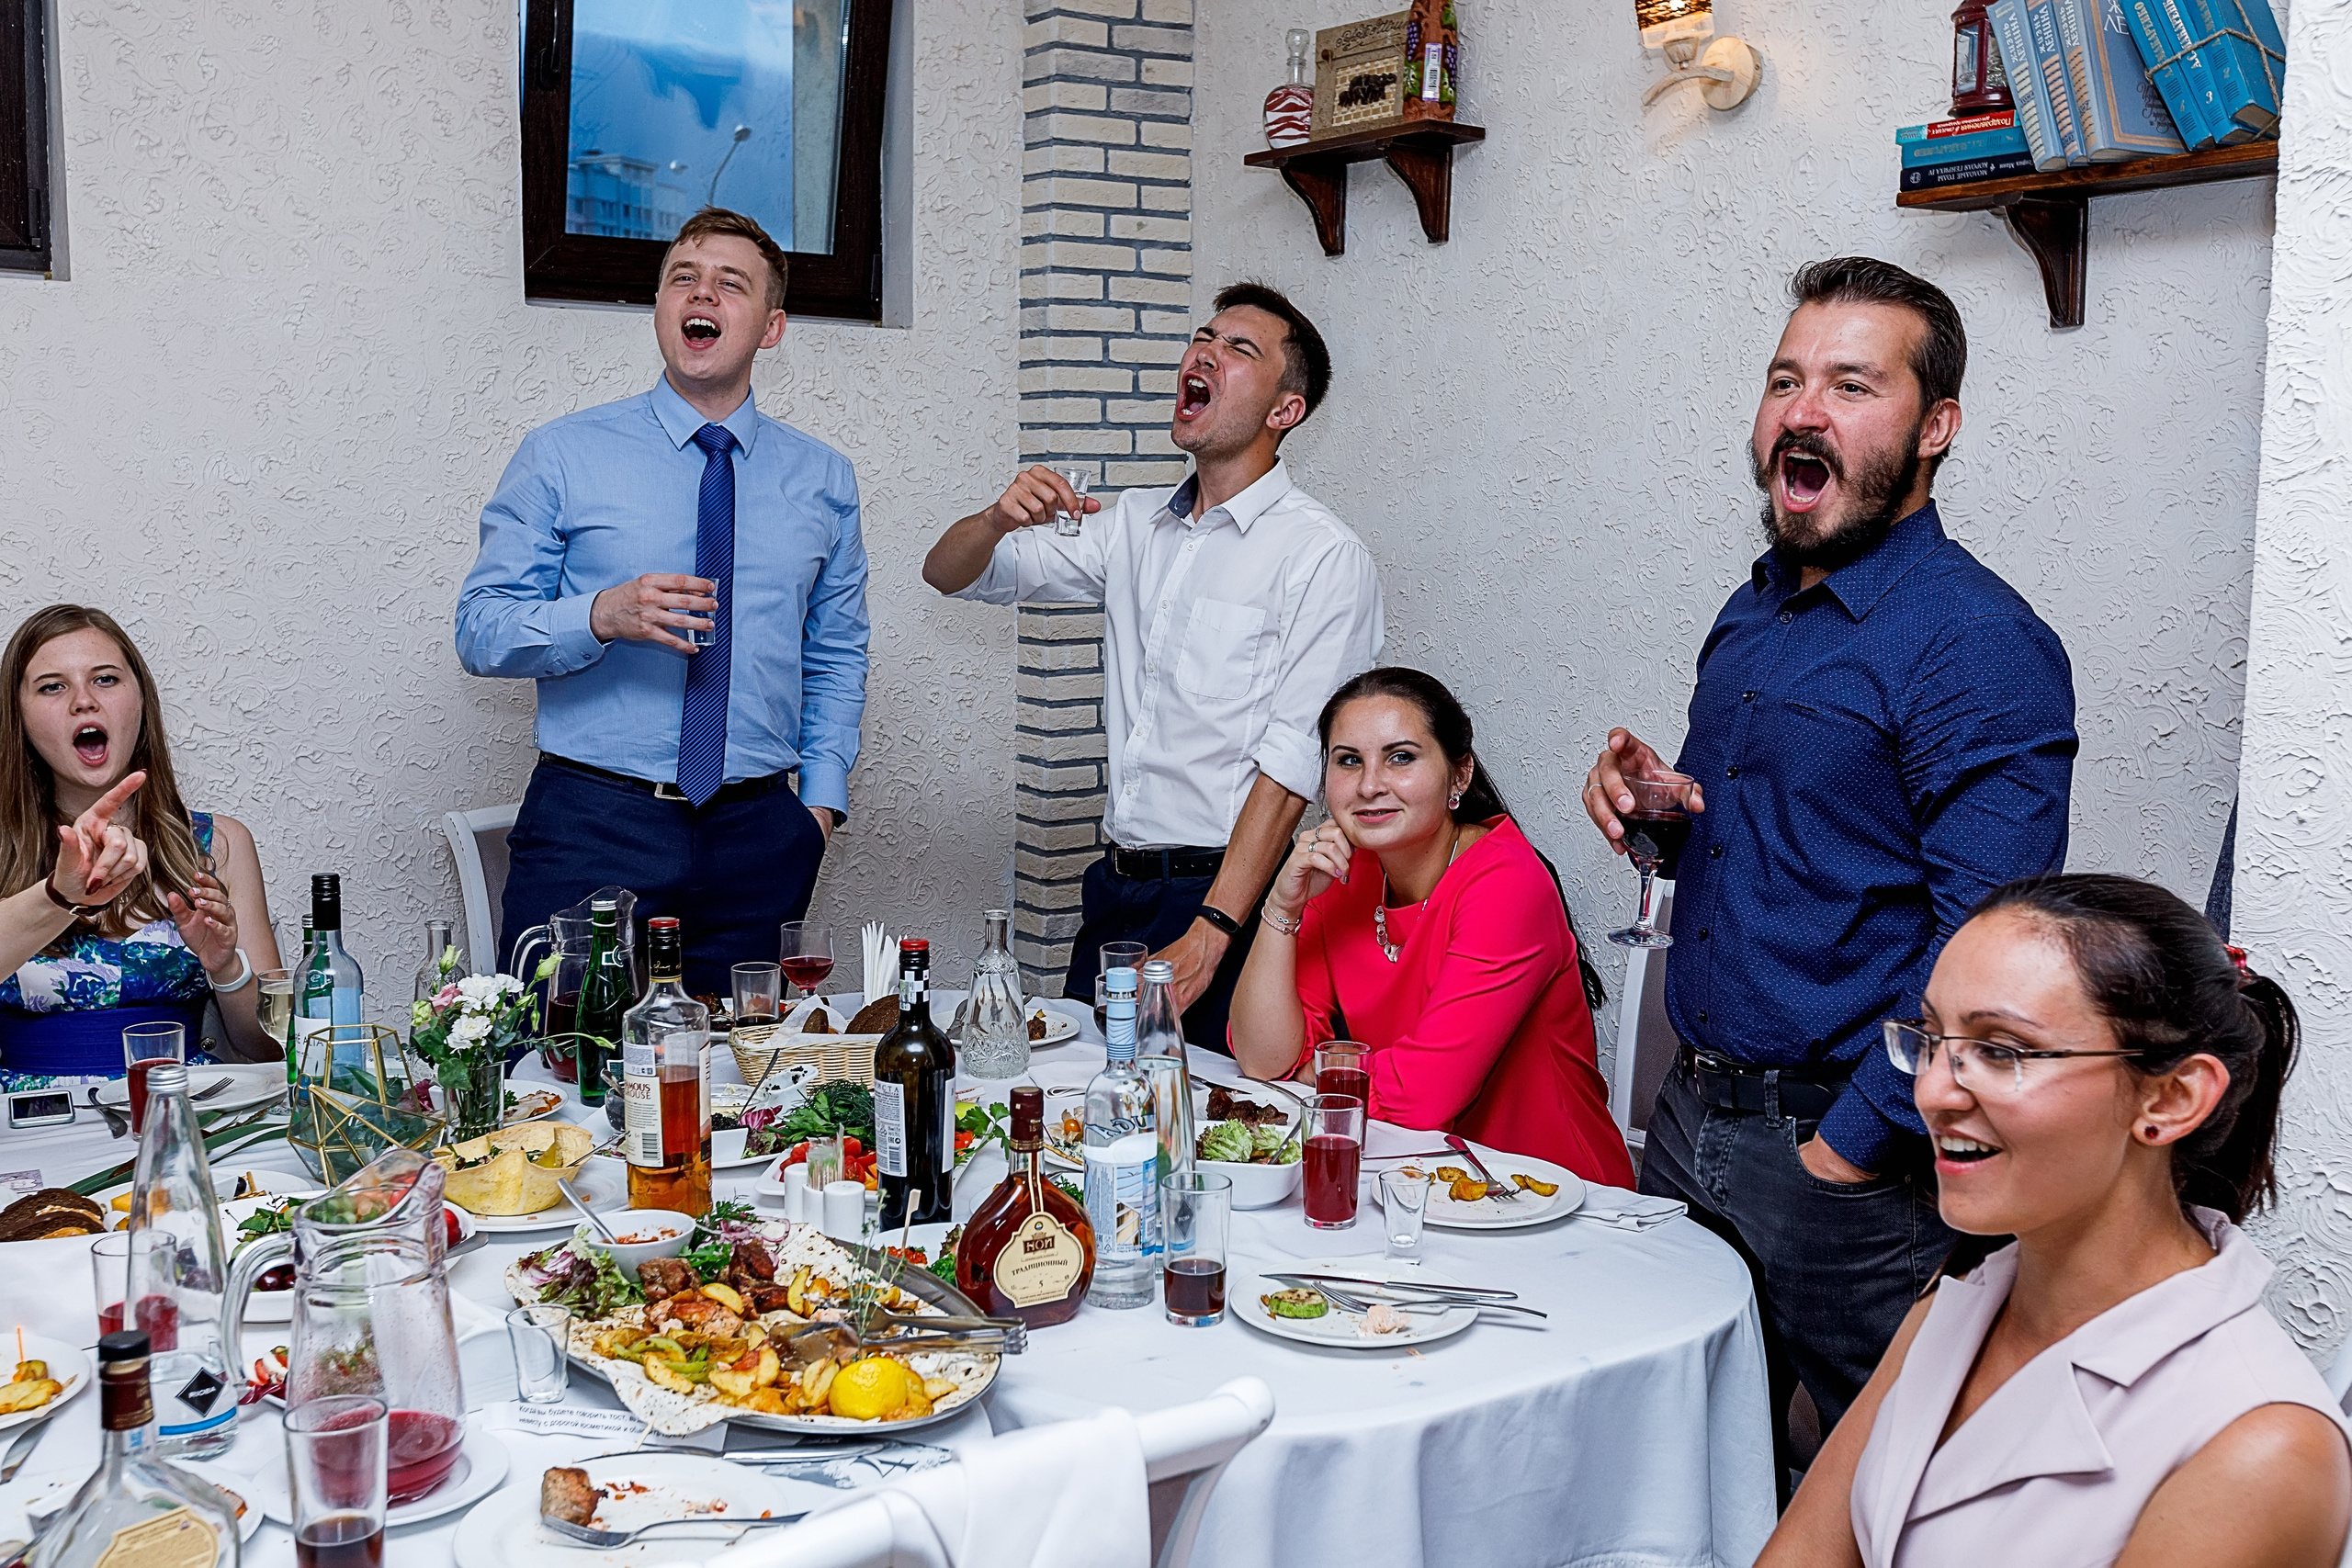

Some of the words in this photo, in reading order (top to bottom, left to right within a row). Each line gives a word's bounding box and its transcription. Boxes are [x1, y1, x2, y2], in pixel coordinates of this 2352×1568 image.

[2033, 12, 2046, 54] ЖИЗНЬ
[2039, 5, 2056, 52] ЛЕНИНА
[2059, 6, 2072, 48] ЖИЗНЬ
[2003, 22, 2018, 63] ЖИЗНЬ
[2007, 12, 2027, 62] ЛЕНИНА
[2205, 90, 2213, 104] 3
[1961, 118, 2011, 130] Поздравления
[1937, 165, 1963, 175] ГЕНРИХА
[1957, 169, 1988, 179] МОЛОДЫЕ
[1963, 162, 1988, 172] КОРОЛЯ
[1012, 1259, 1068, 1277] ТРАДИЦИОННЫЙ
[548, 1408, 574, 1416] будете
